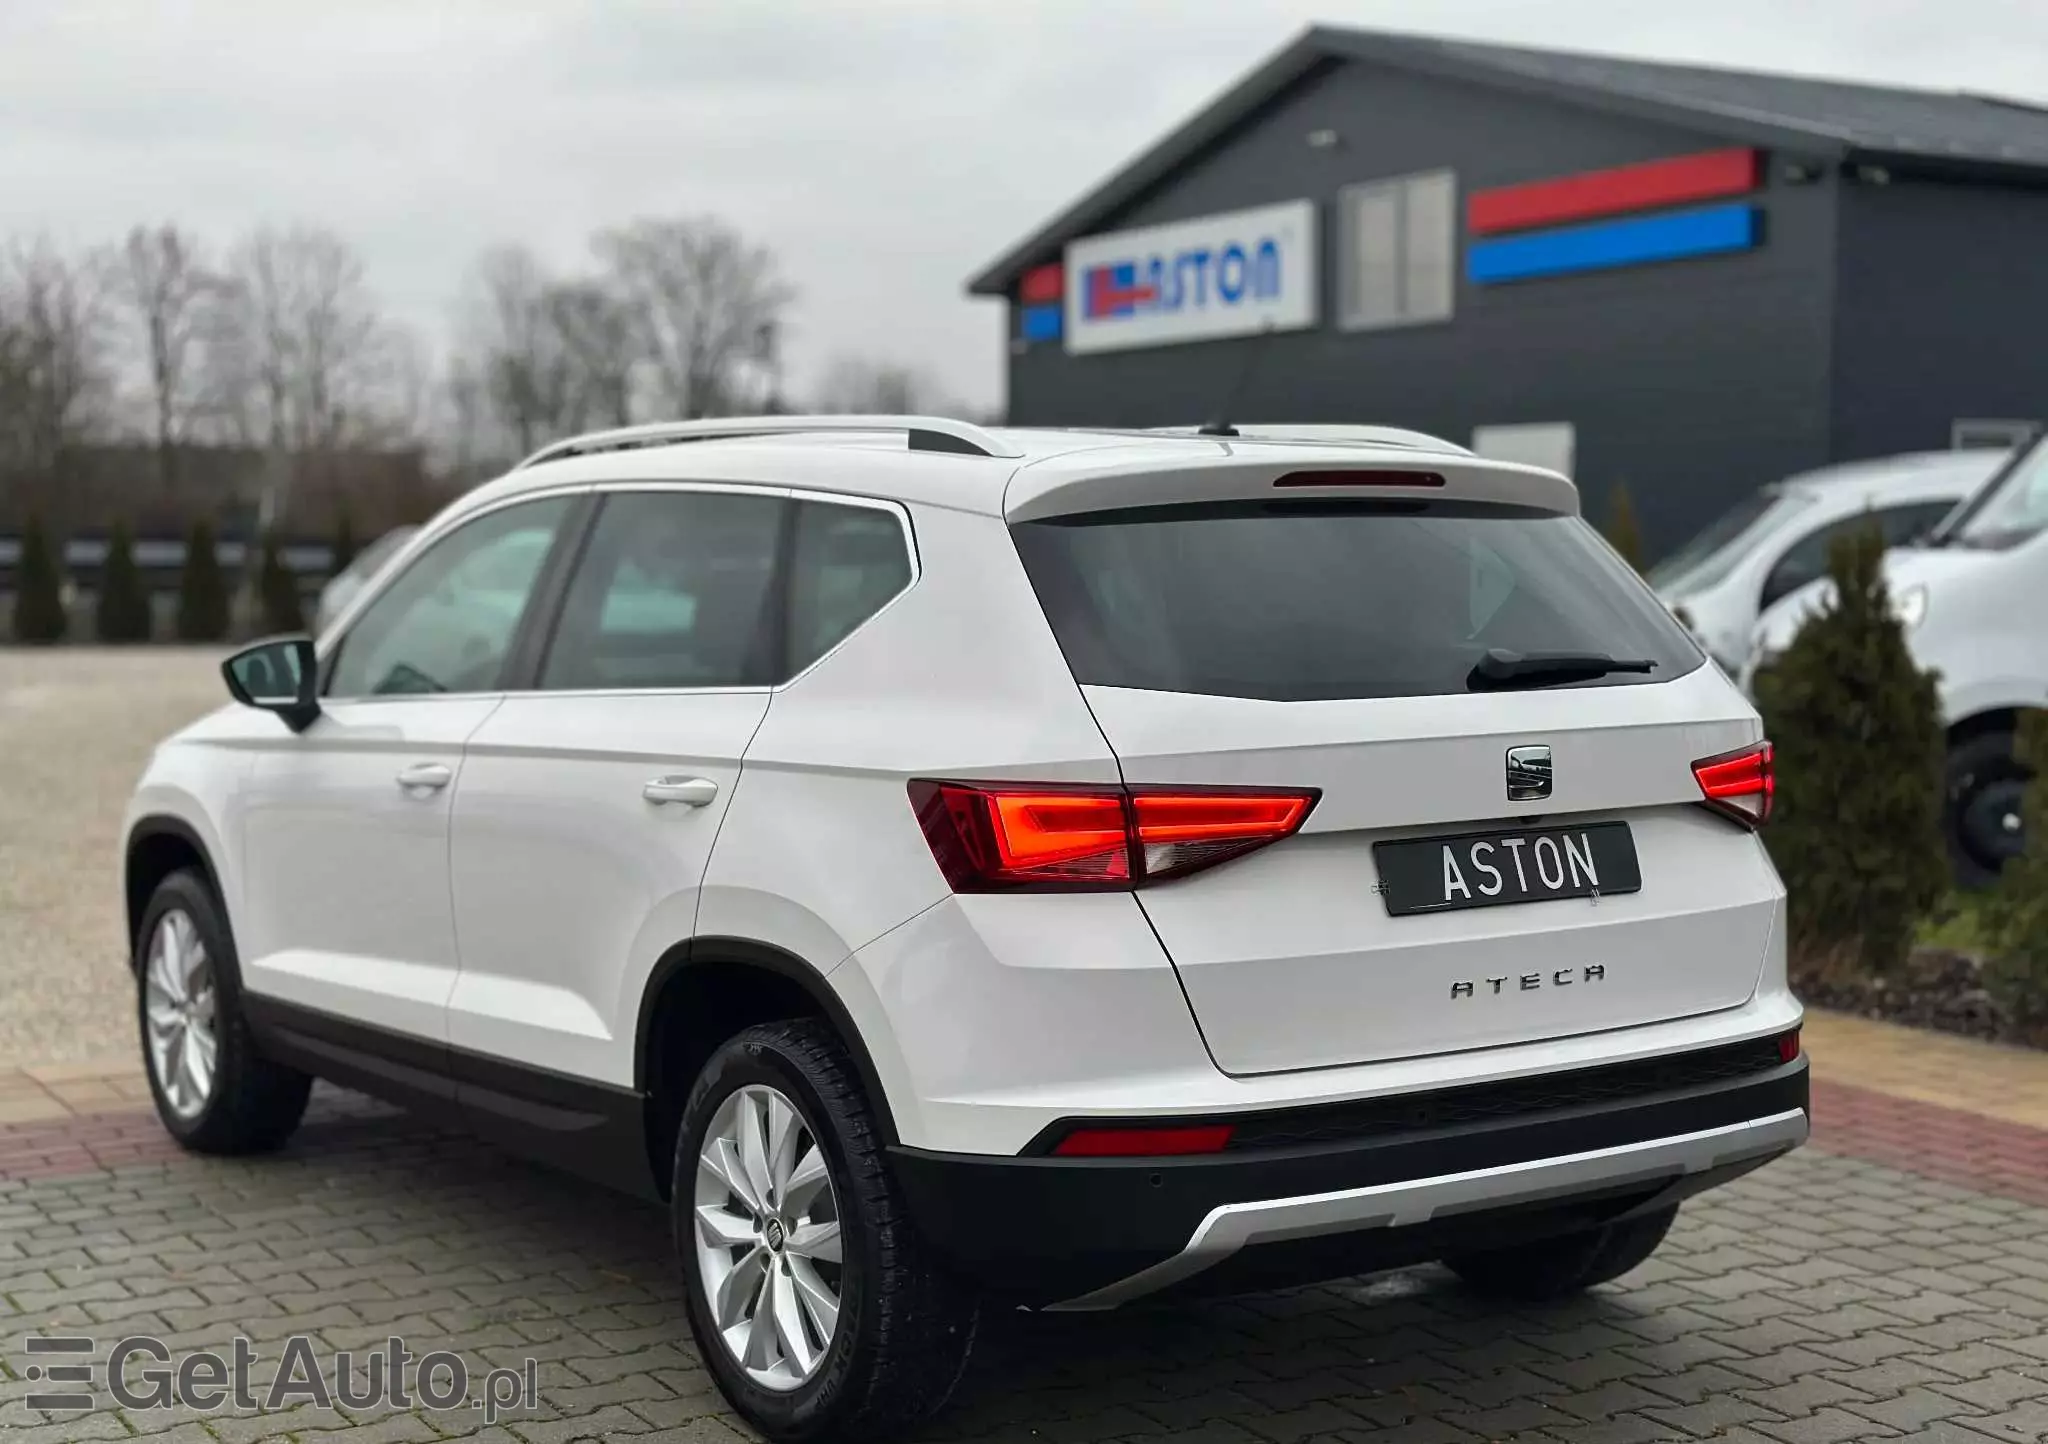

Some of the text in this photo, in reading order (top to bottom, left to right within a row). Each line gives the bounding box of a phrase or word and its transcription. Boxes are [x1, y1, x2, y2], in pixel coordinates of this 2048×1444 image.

[1136, 238, 1282, 310] ASTON
[1442, 833, 1599, 901] ASTON
[1451, 964, 1605, 1000] ATECA
